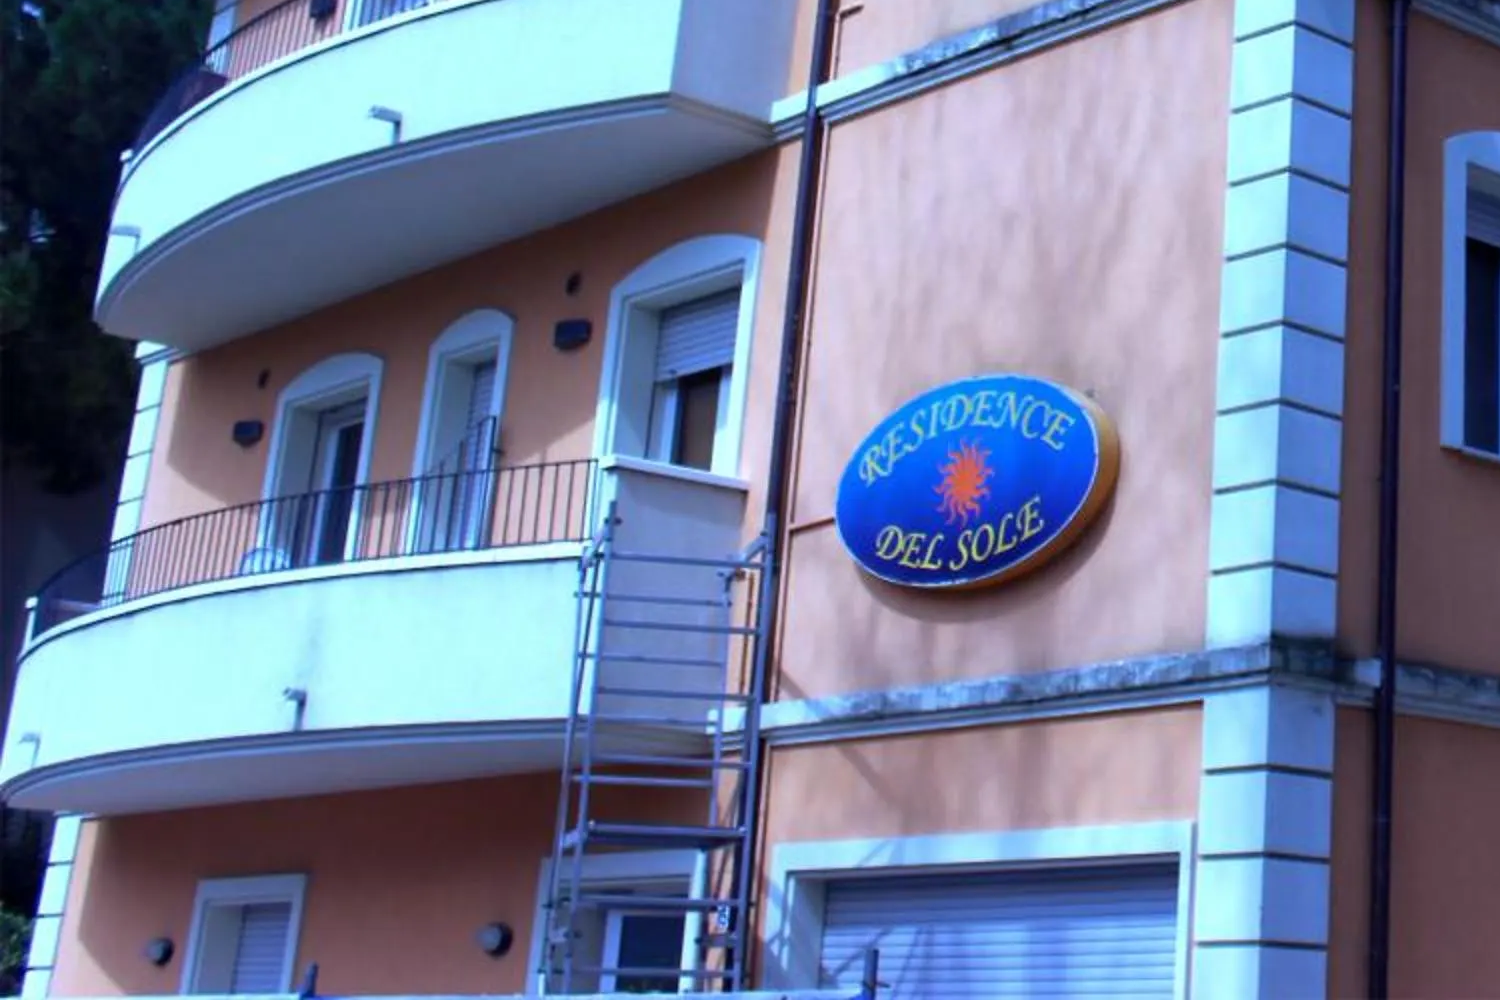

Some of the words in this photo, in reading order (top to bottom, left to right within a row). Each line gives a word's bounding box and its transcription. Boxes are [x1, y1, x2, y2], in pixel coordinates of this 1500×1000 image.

[858, 390, 1075, 486] RESIDENCE
[875, 525, 945, 570] DEL
[950, 495, 1045, 571] SOLE
